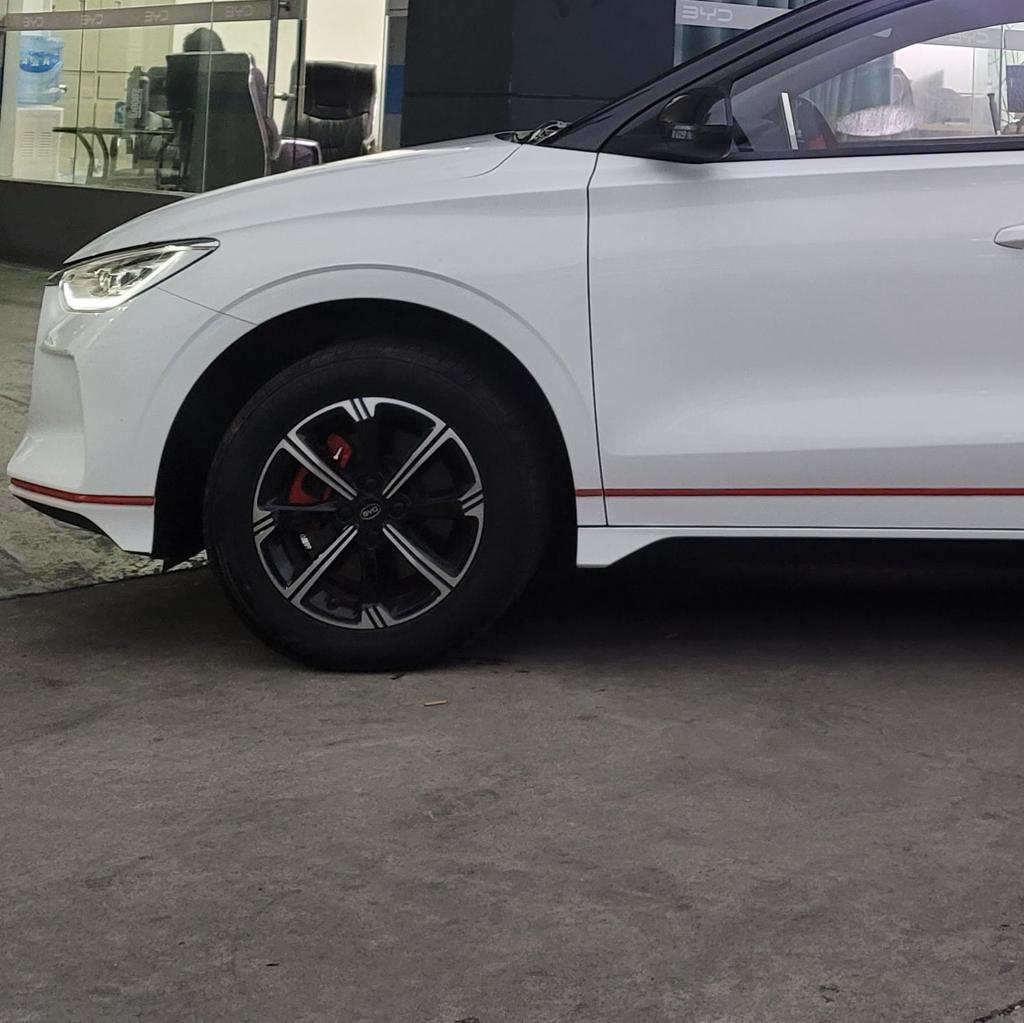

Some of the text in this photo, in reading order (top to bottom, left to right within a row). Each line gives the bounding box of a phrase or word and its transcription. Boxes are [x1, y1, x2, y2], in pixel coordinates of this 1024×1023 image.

[23, 5, 254, 27] BYD BYD BYD BYD
[682, 5, 733, 22] BYD
